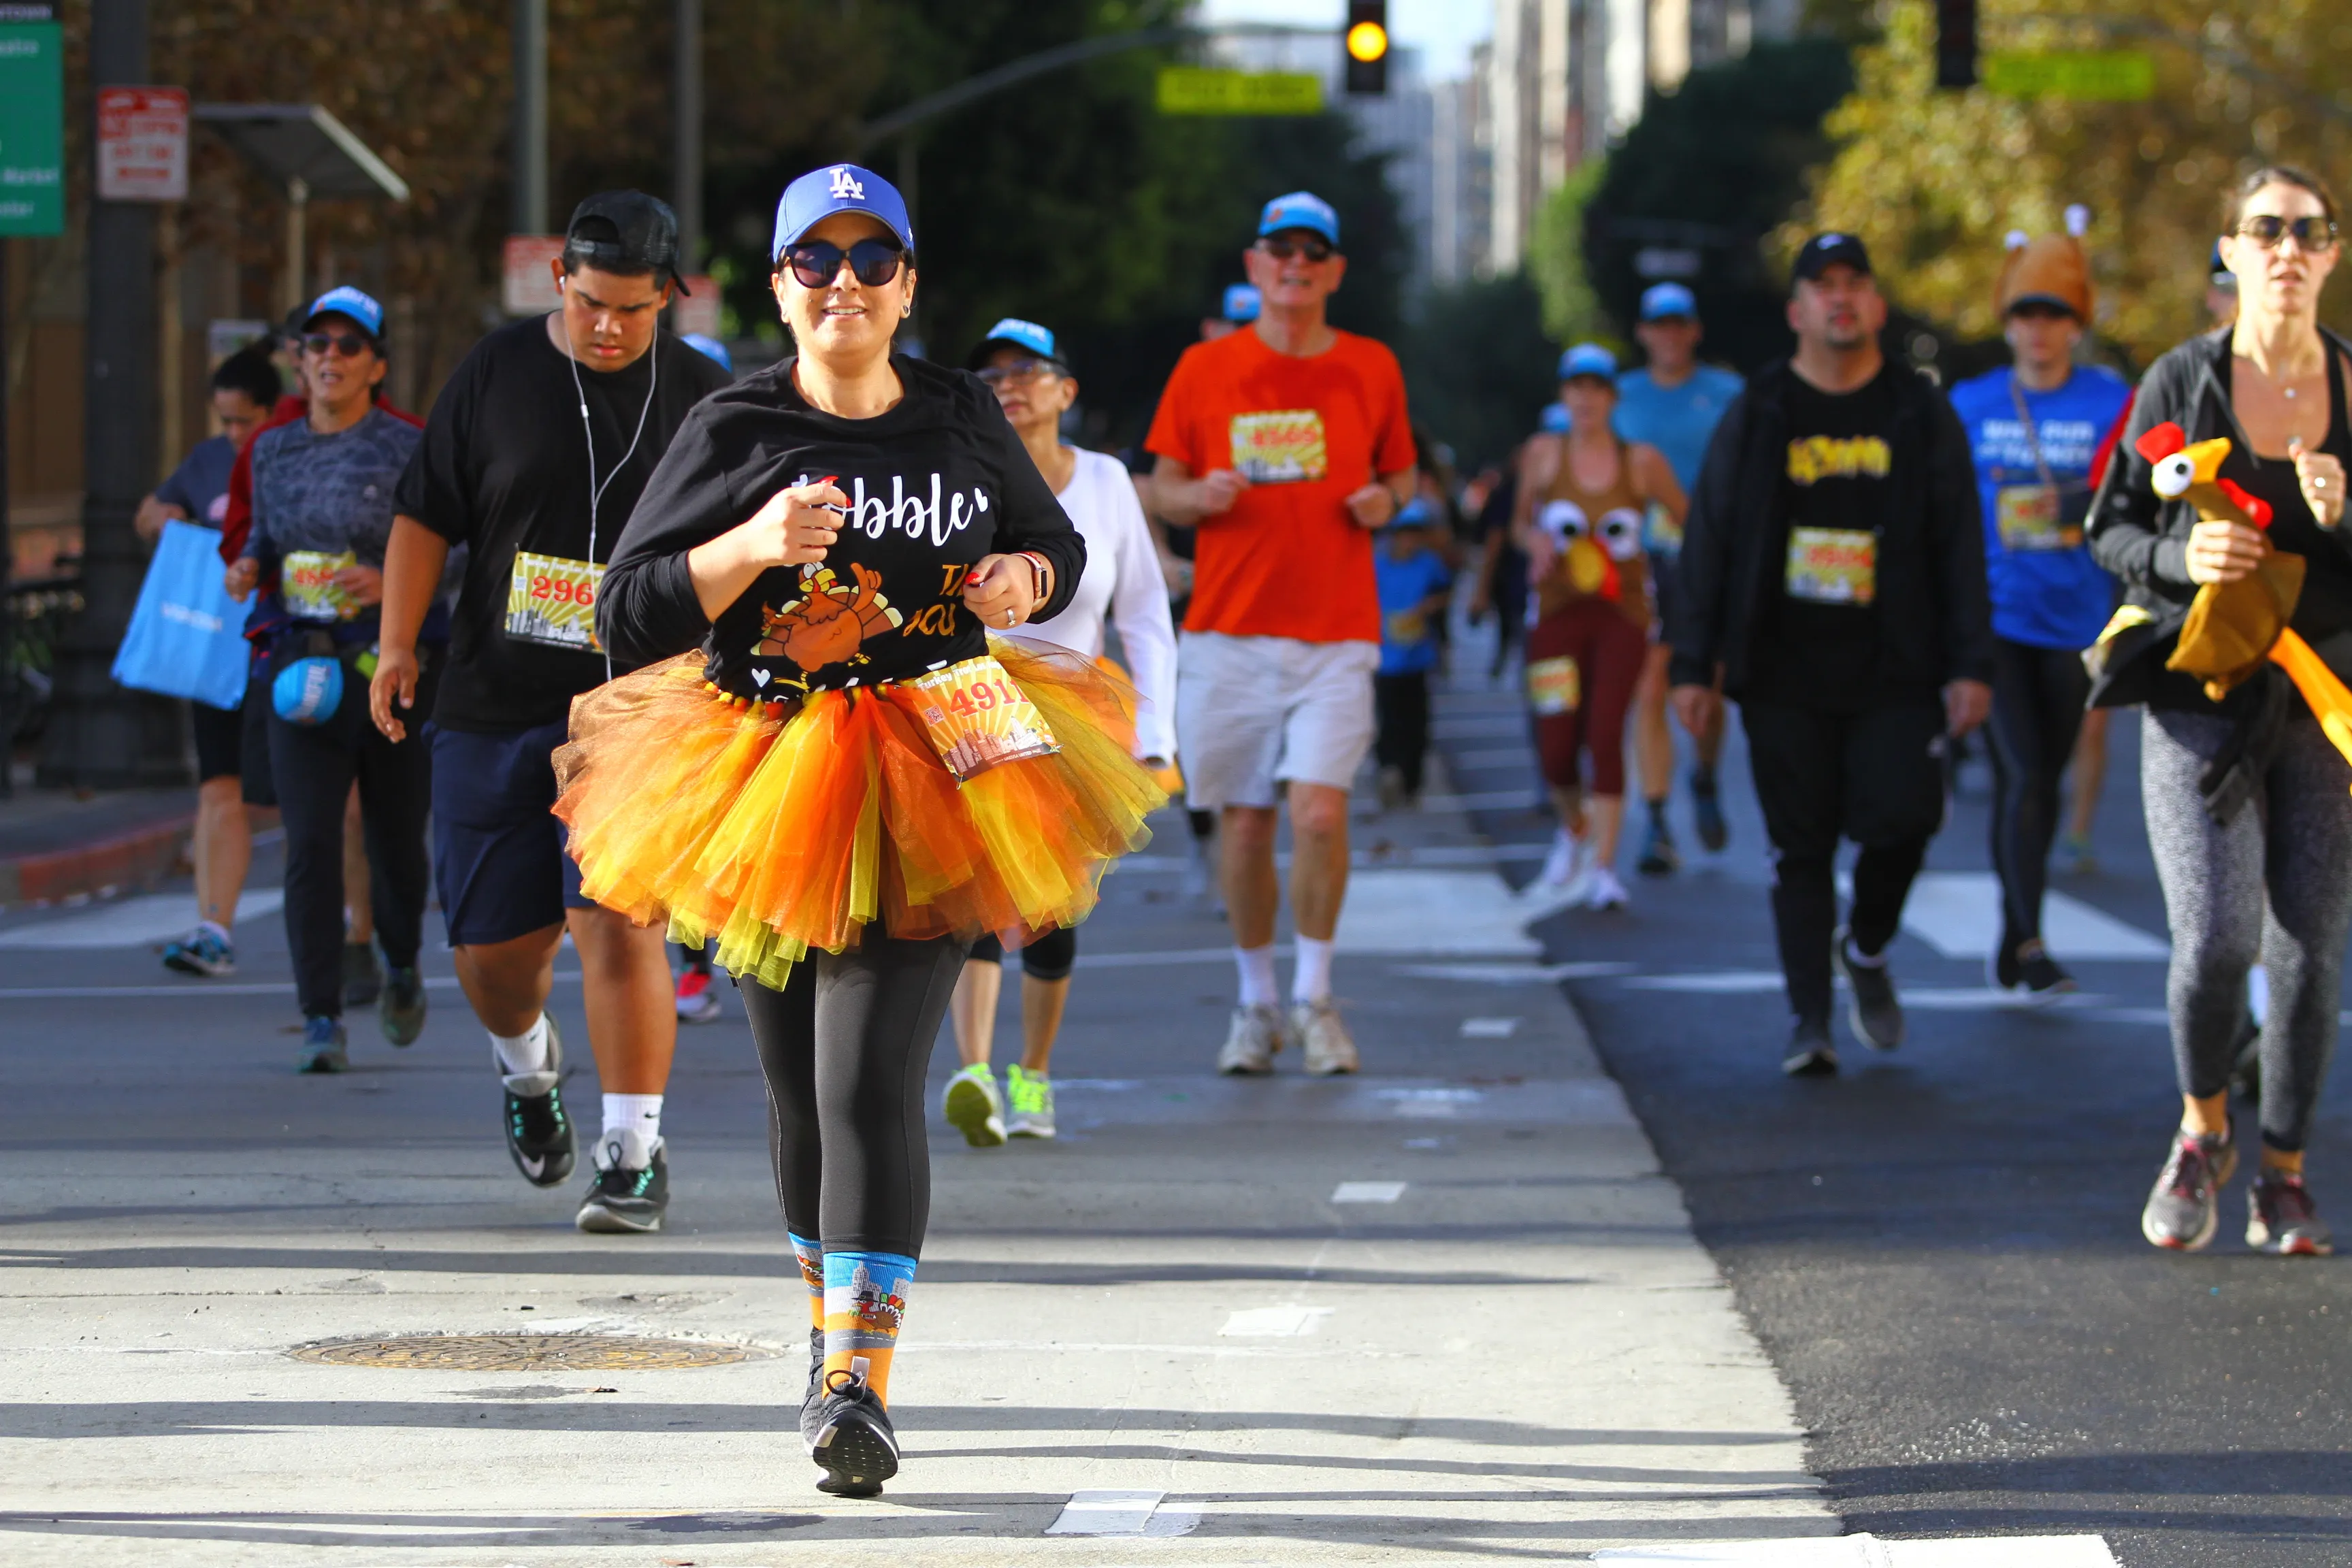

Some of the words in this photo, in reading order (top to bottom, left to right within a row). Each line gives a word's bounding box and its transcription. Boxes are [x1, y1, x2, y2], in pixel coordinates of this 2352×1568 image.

[829, 167, 865, 200] LA
[917, 672, 953, 691] Turkey
[953, 666, 973, 677] Trot
[949, 679, 1030, 717] 4911
